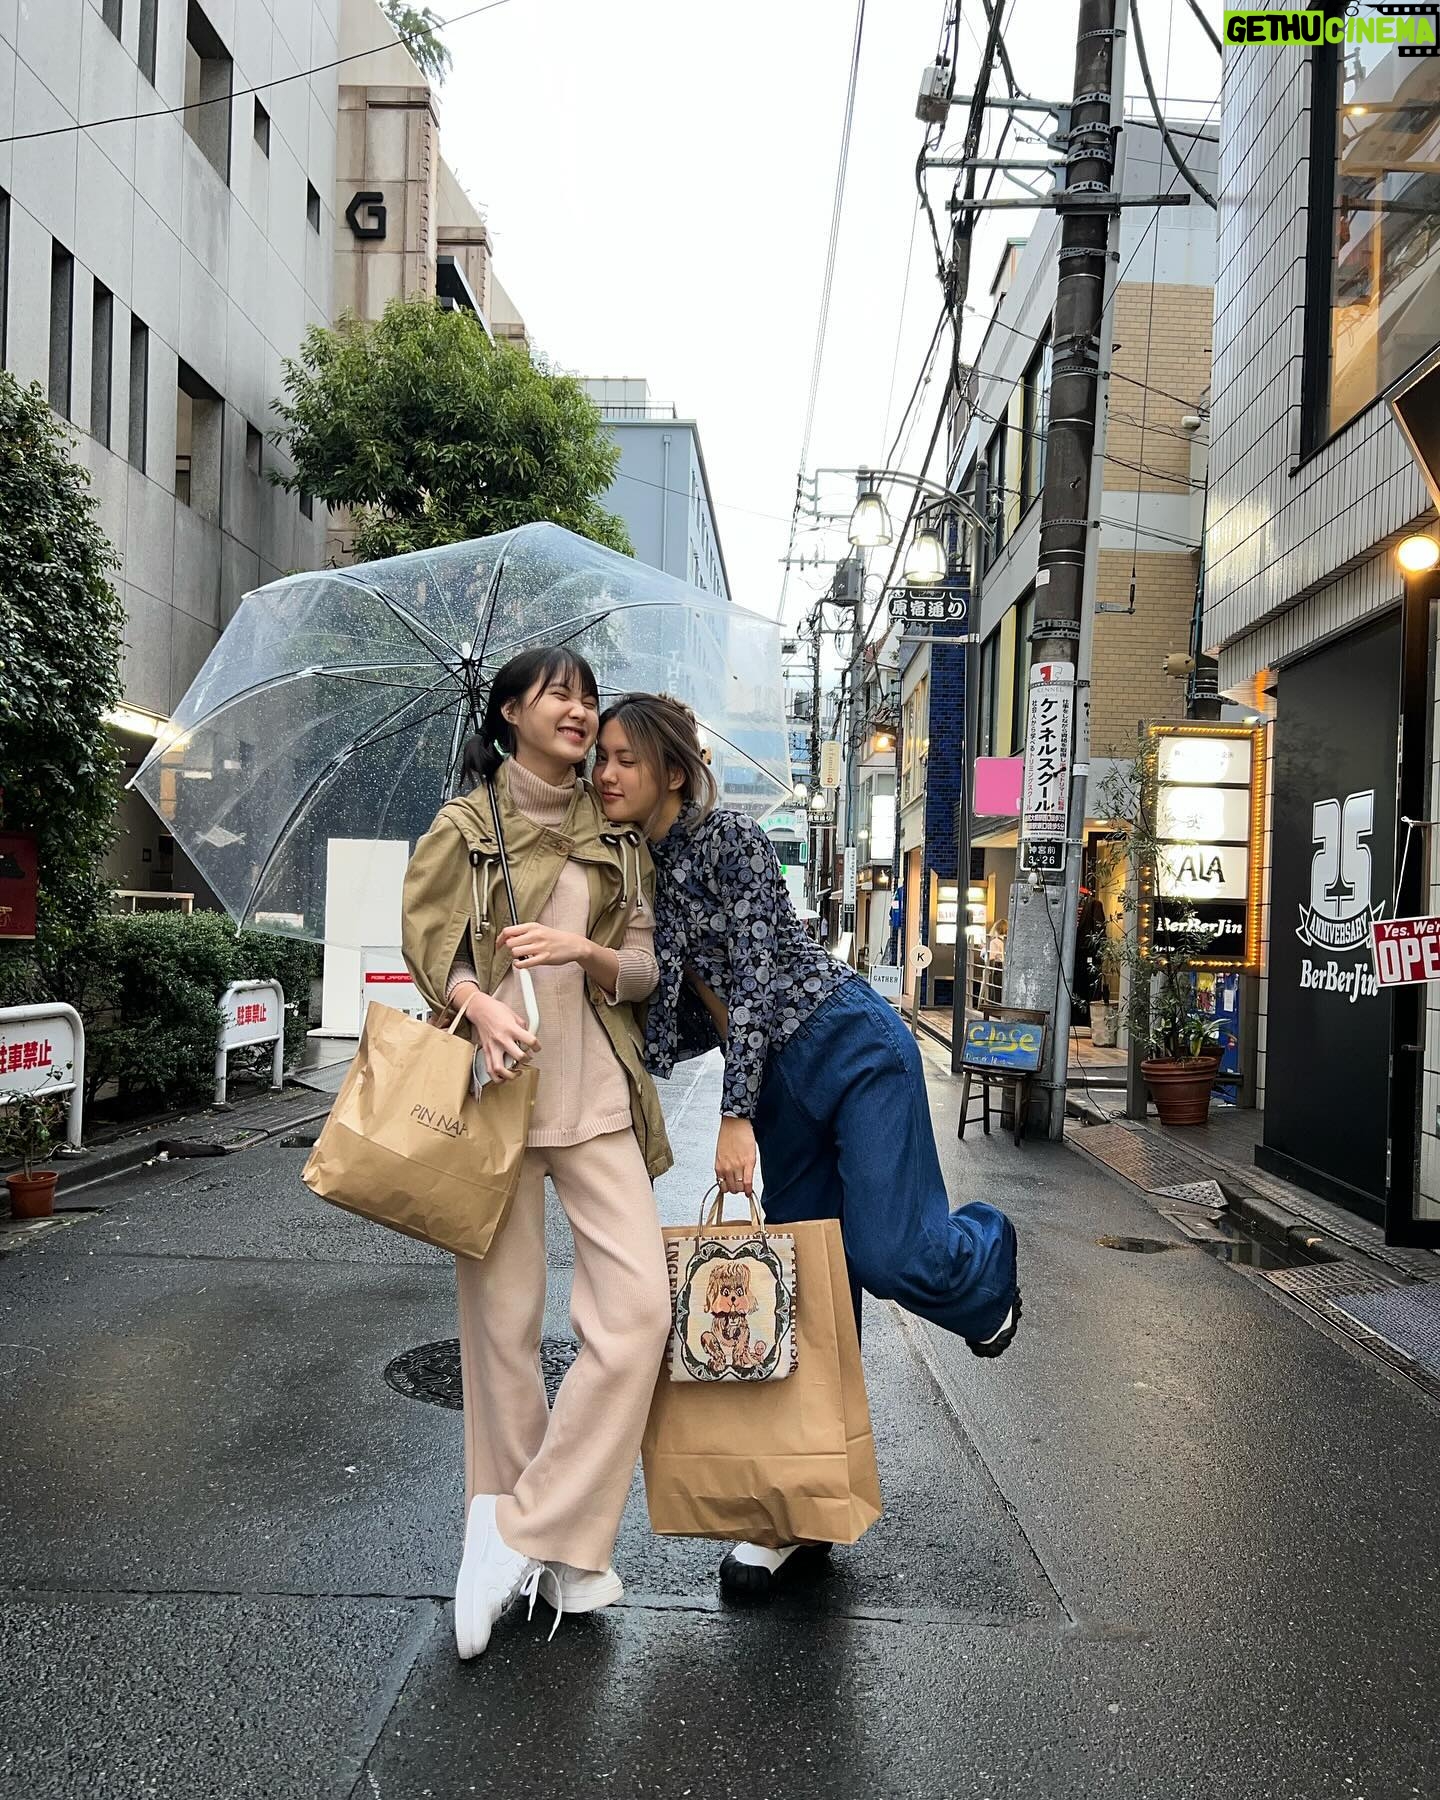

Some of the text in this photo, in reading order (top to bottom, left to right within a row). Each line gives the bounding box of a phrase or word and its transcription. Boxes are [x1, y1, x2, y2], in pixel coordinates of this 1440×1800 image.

[891, 600, 963, 617] 原宿通り
[1029, 846, 1055, 854] 神宮前
[1309, 911, 1369, 945] ANNIVERSARY
[1383, 924, 1411, 938] Yes.
[917, 952, 925, 962] K
[1379, 935, 1440, 983] OPE
[873, 975, 898, 984] GATHER
[1300, 959, 1379, 1003] BerBerJin
[237, 1003, 267, 1026] 駐車禁止
[410, 1104, 436, 1123] PIN
